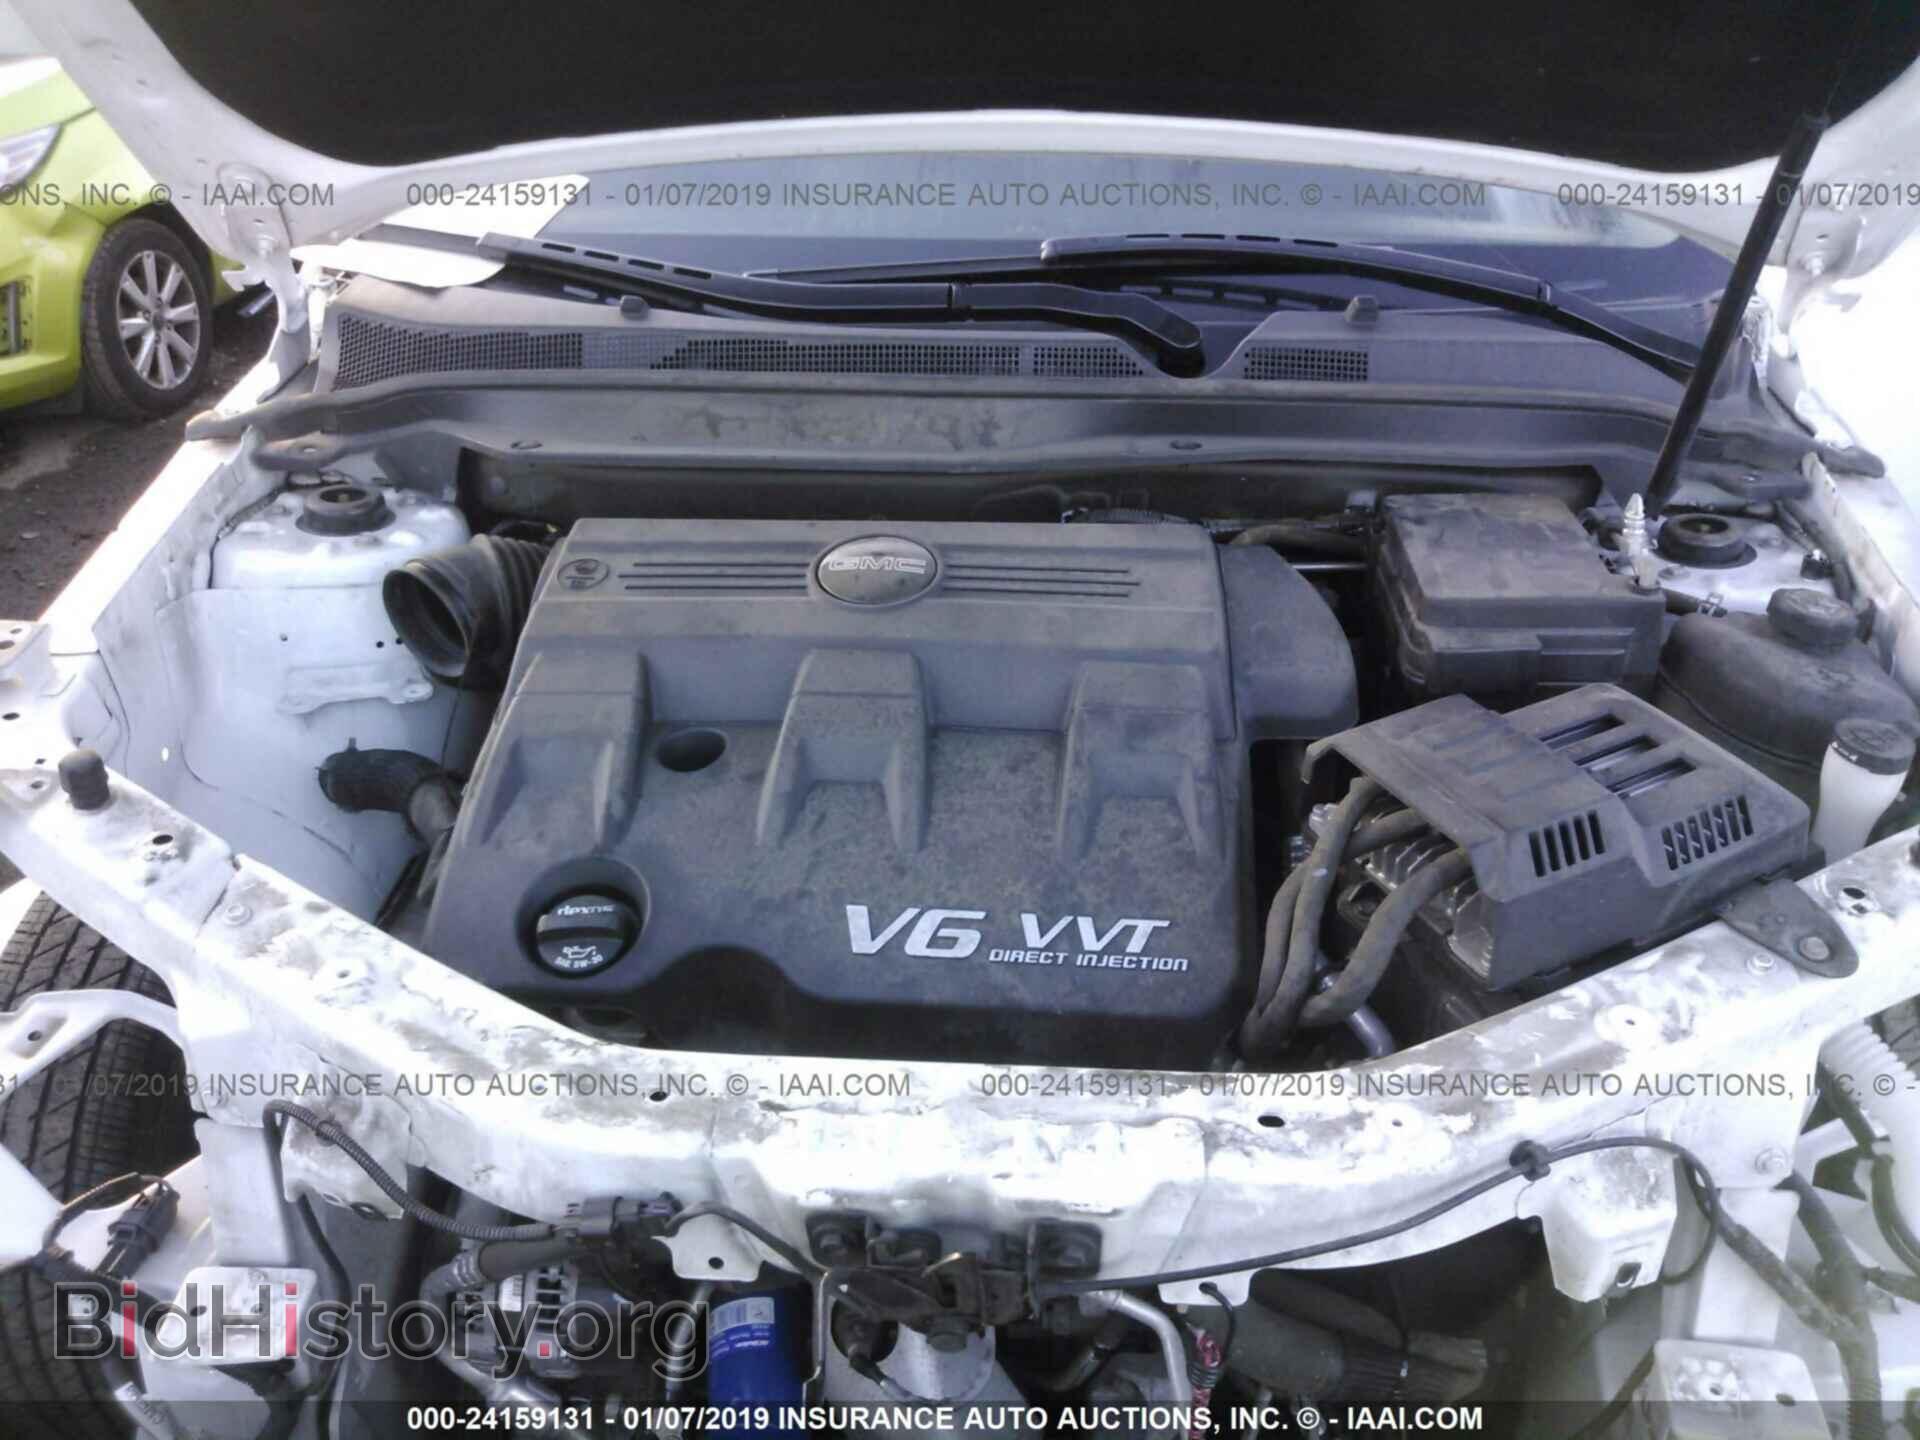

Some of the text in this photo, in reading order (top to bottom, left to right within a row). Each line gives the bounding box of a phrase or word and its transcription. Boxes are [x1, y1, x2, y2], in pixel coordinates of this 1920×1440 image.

[829, 556, 926, 574] GMC
[846, 904, 1170, 958] V6 VVT
[988, 949, 1188, 971] DIRECT INJECTION
